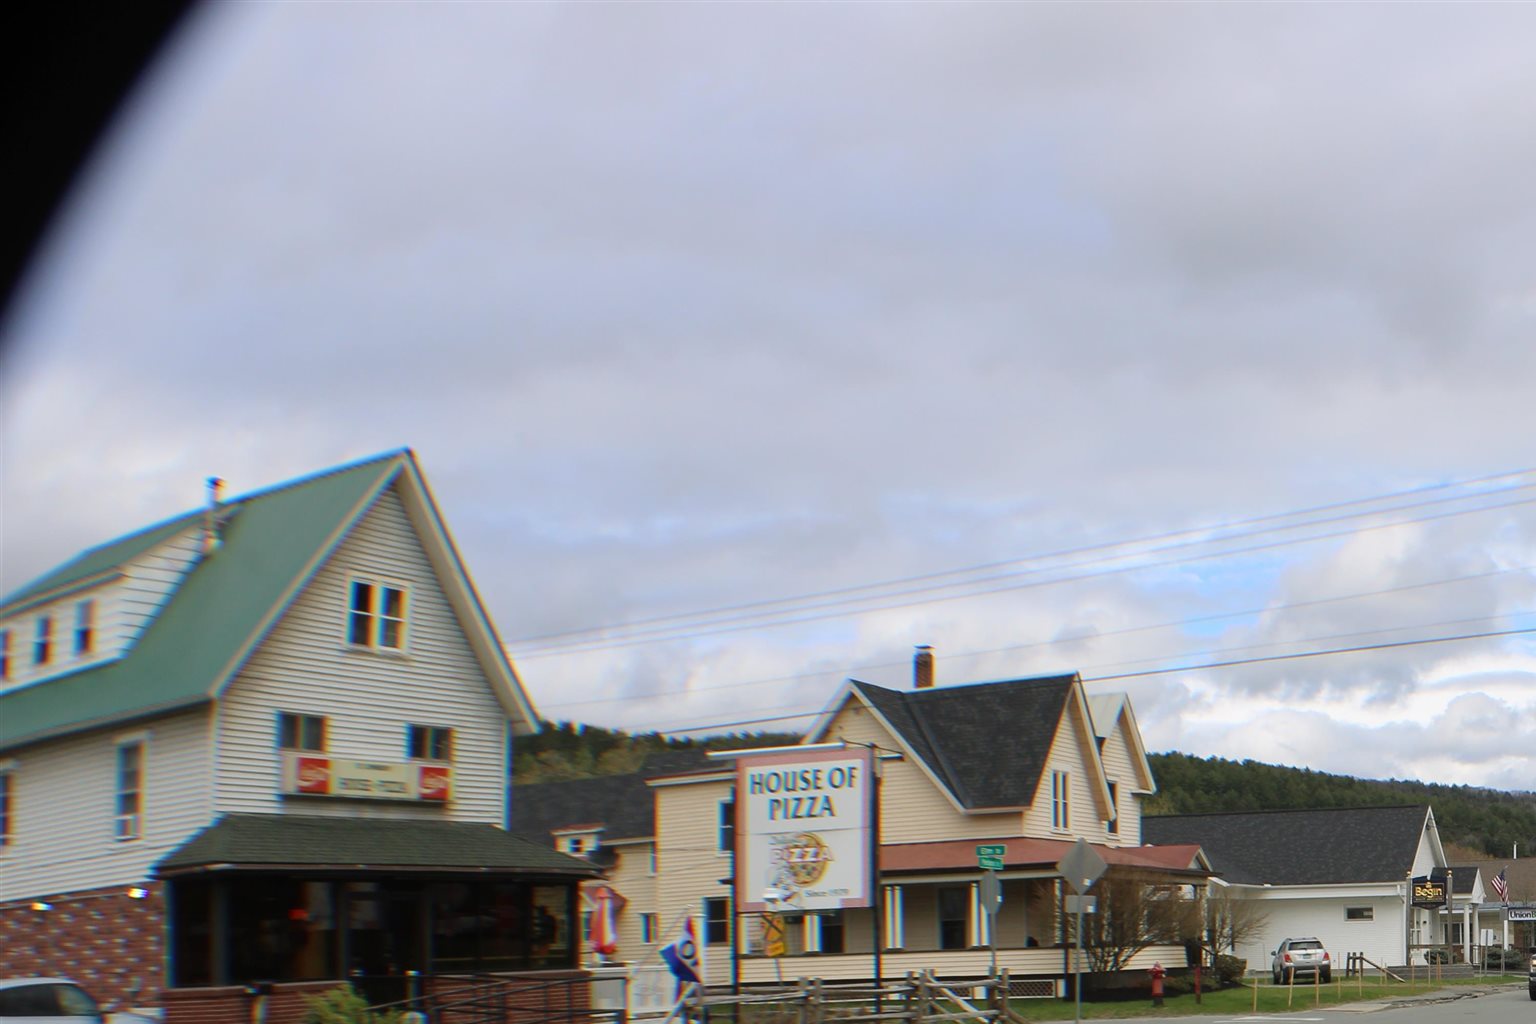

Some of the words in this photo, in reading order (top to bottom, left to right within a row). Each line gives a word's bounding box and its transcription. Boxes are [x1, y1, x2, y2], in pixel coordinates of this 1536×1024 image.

[750, 768, 823, 794] HOUSE
[827, 766, 857, 789] OF
[768, 795, 835, 820] PIZZA
[1415, 886, 1442, 898] Begin
